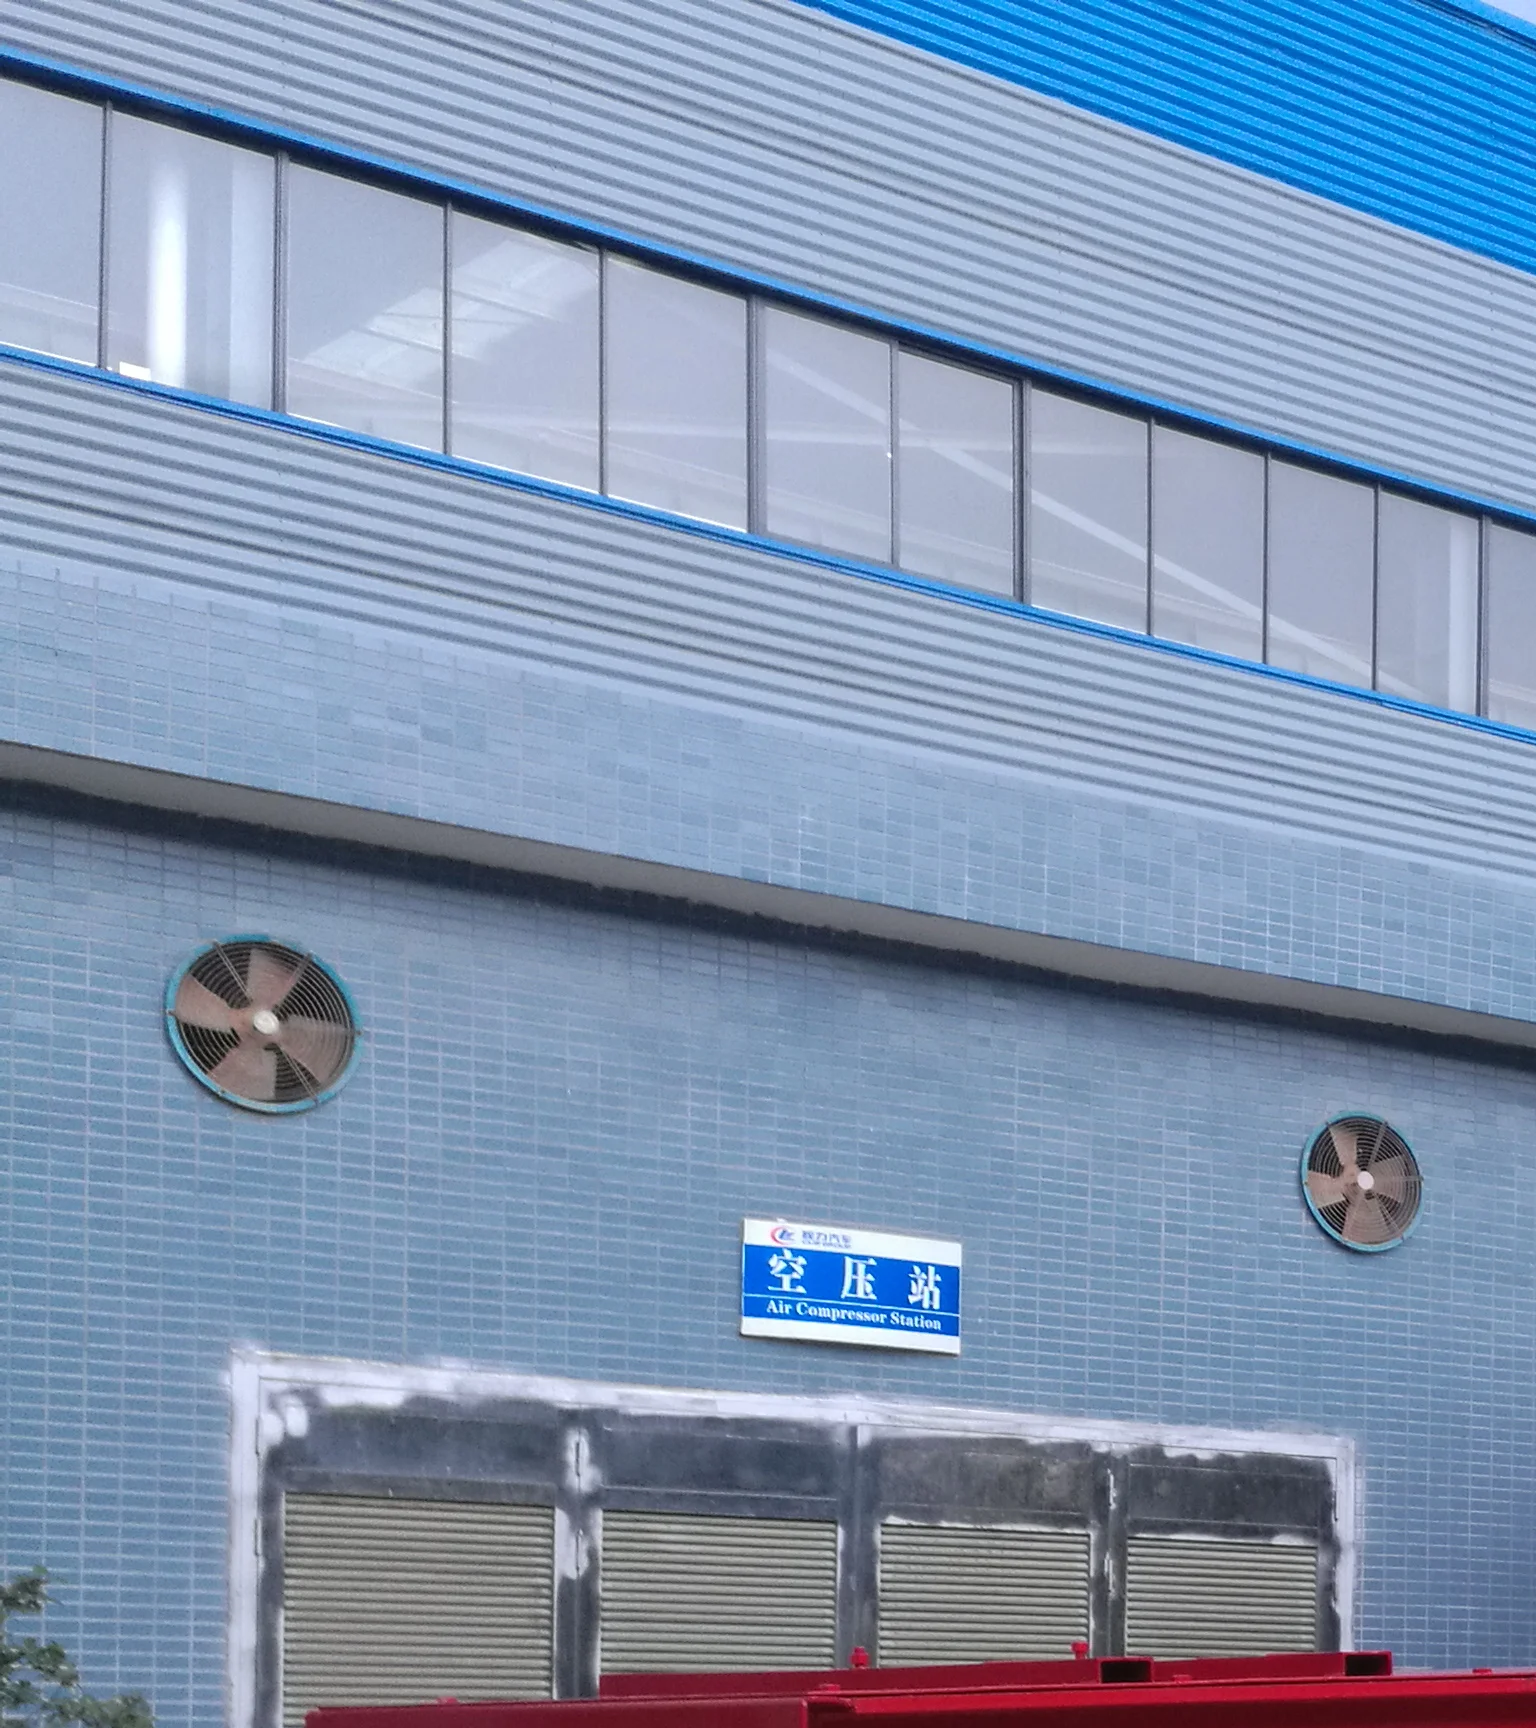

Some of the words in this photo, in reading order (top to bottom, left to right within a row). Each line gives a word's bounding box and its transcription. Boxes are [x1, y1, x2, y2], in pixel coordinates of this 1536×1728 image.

[767, 1248, 942, 1310] 空压站
[766, 1300, 793, 1315] Air
[796, 1302, 887, 1325] Compressor
[890, 1311, 942, 1331] Station
